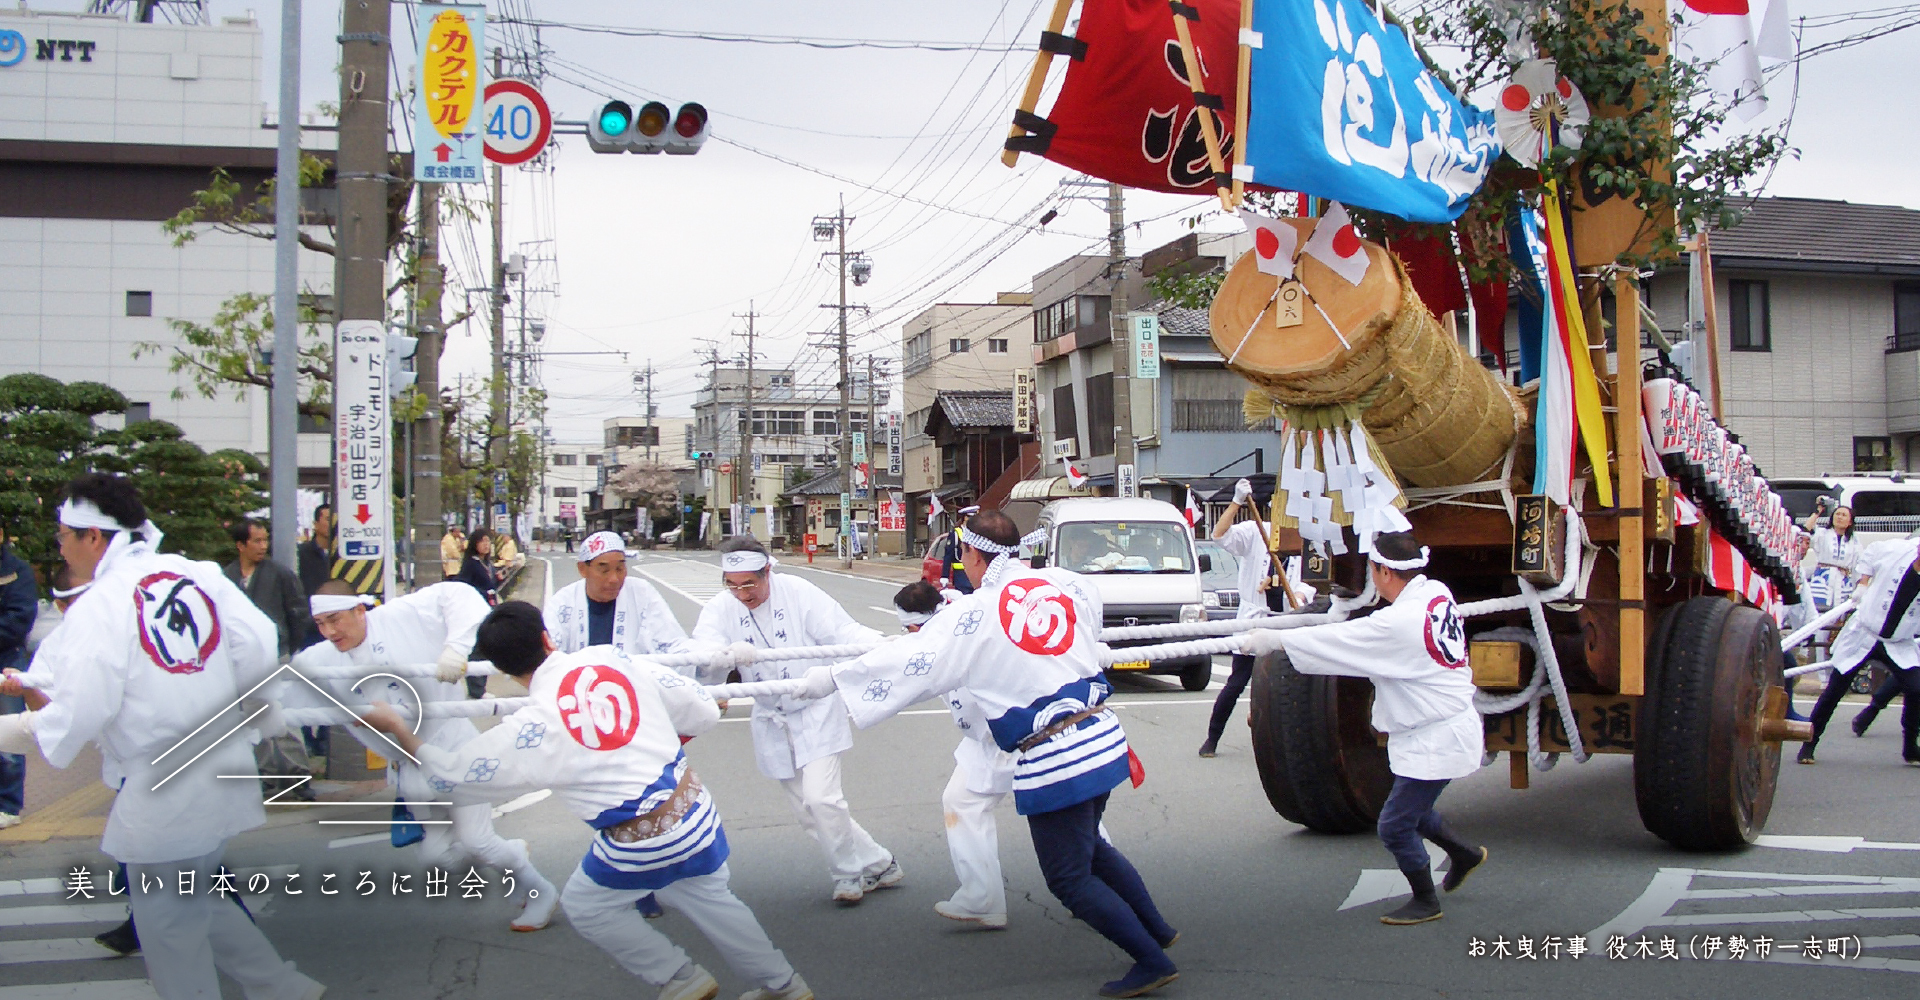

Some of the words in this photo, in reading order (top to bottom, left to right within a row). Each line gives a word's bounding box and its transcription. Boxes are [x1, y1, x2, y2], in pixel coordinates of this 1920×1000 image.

[429, 12, 476, 24] パーラー
[36, 38, 96, 62] NTT
[433, 30, 469, 126] カクテル
[487, 104, 532, 140] 40
[423, 165, 476, 179] 度会橋西
[1142, 318, 1152, 341] 出口
[368, 352, 382, 490] ドコモショップ
[1017, 374, 1028, 429] 駒田洋服店
[349, 403, 367, 501] 宇治山田店
[890, 427, 901, 474] 出口造花店
